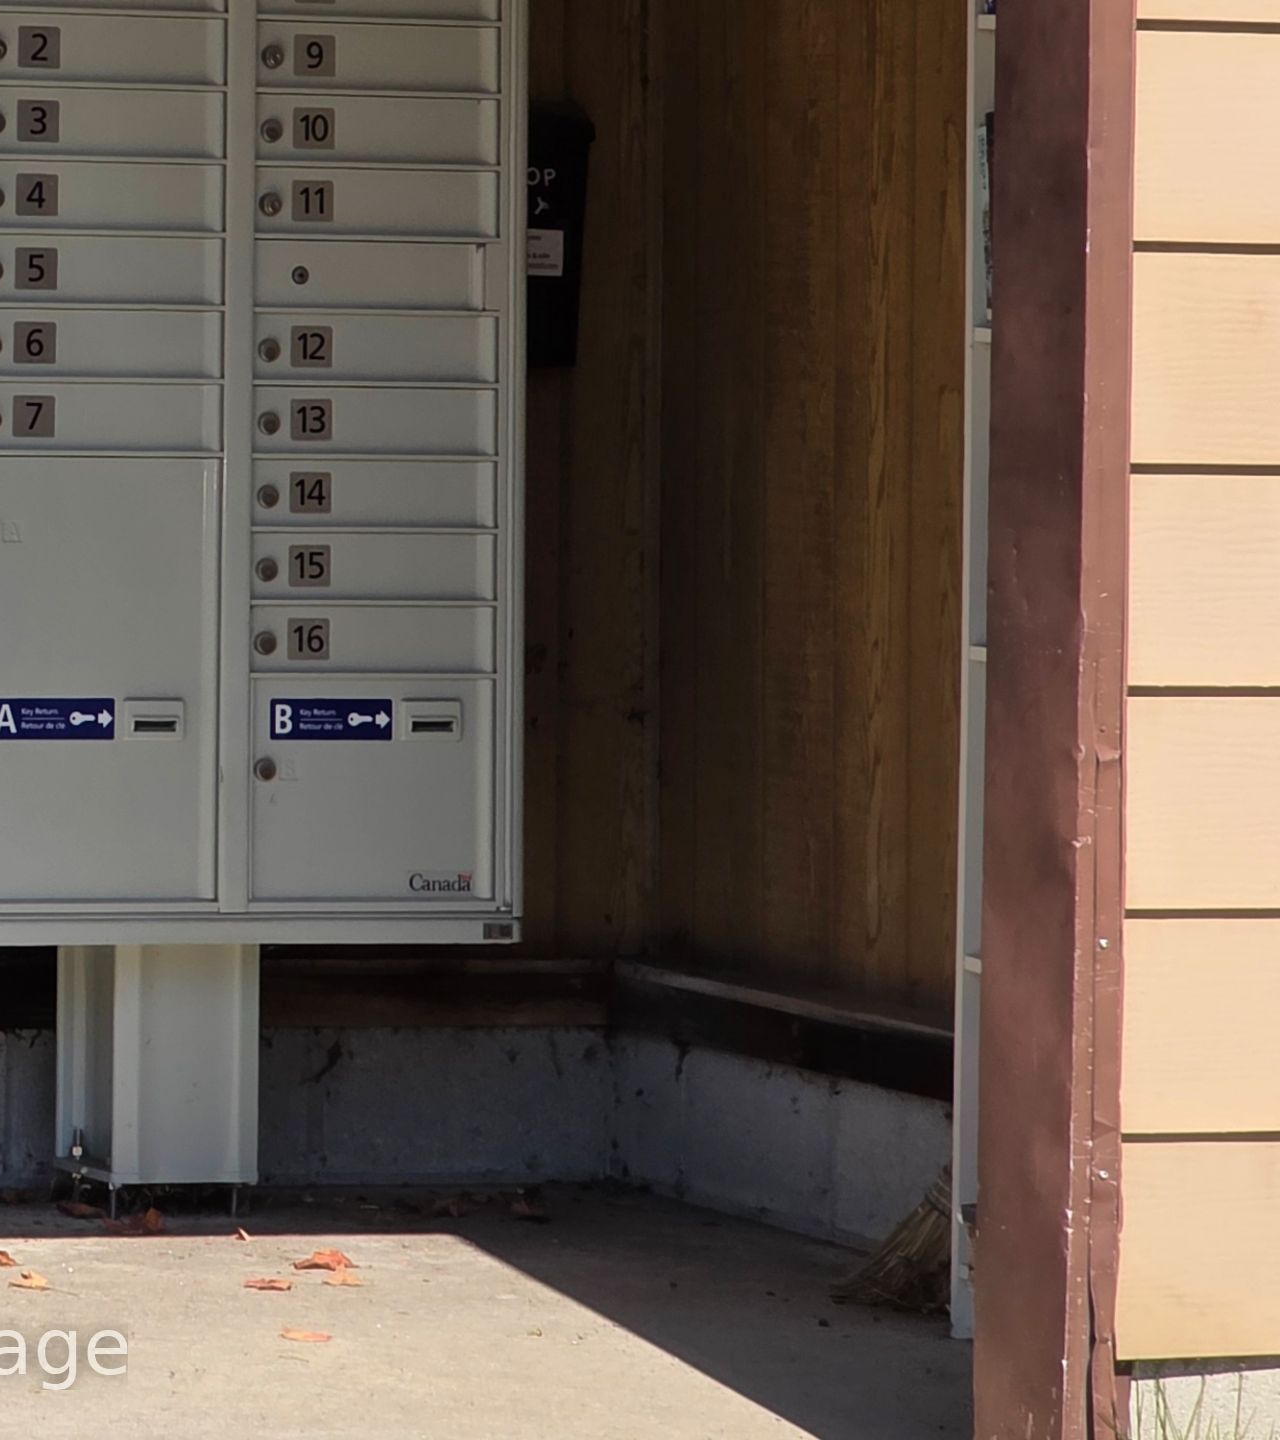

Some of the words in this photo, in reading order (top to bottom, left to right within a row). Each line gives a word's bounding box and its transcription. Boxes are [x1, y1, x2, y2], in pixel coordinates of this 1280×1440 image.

[30, 33, 49, 62] 2
[306, 41, 324, 69] 9
[29, 106, 47, 135] 3
[299, 114, 329, 142] 10
[25, 180, 46, 209] 4
[299, 186, 325, 215] 11
[27, 253, 45, 283] 5
[25, 328, 44, 357] 6
[297, 332, 326, 361] 12
[25, 401, 43, 431] 7
[296, 405, 326, 434] 13
[295, 478, 326, 506] 14
[294, 551, 325, 580] 15
[293, 624, 325, 653] 16
[274, 703, 293, 734] B
[408, 872, 472, 892] Canada
